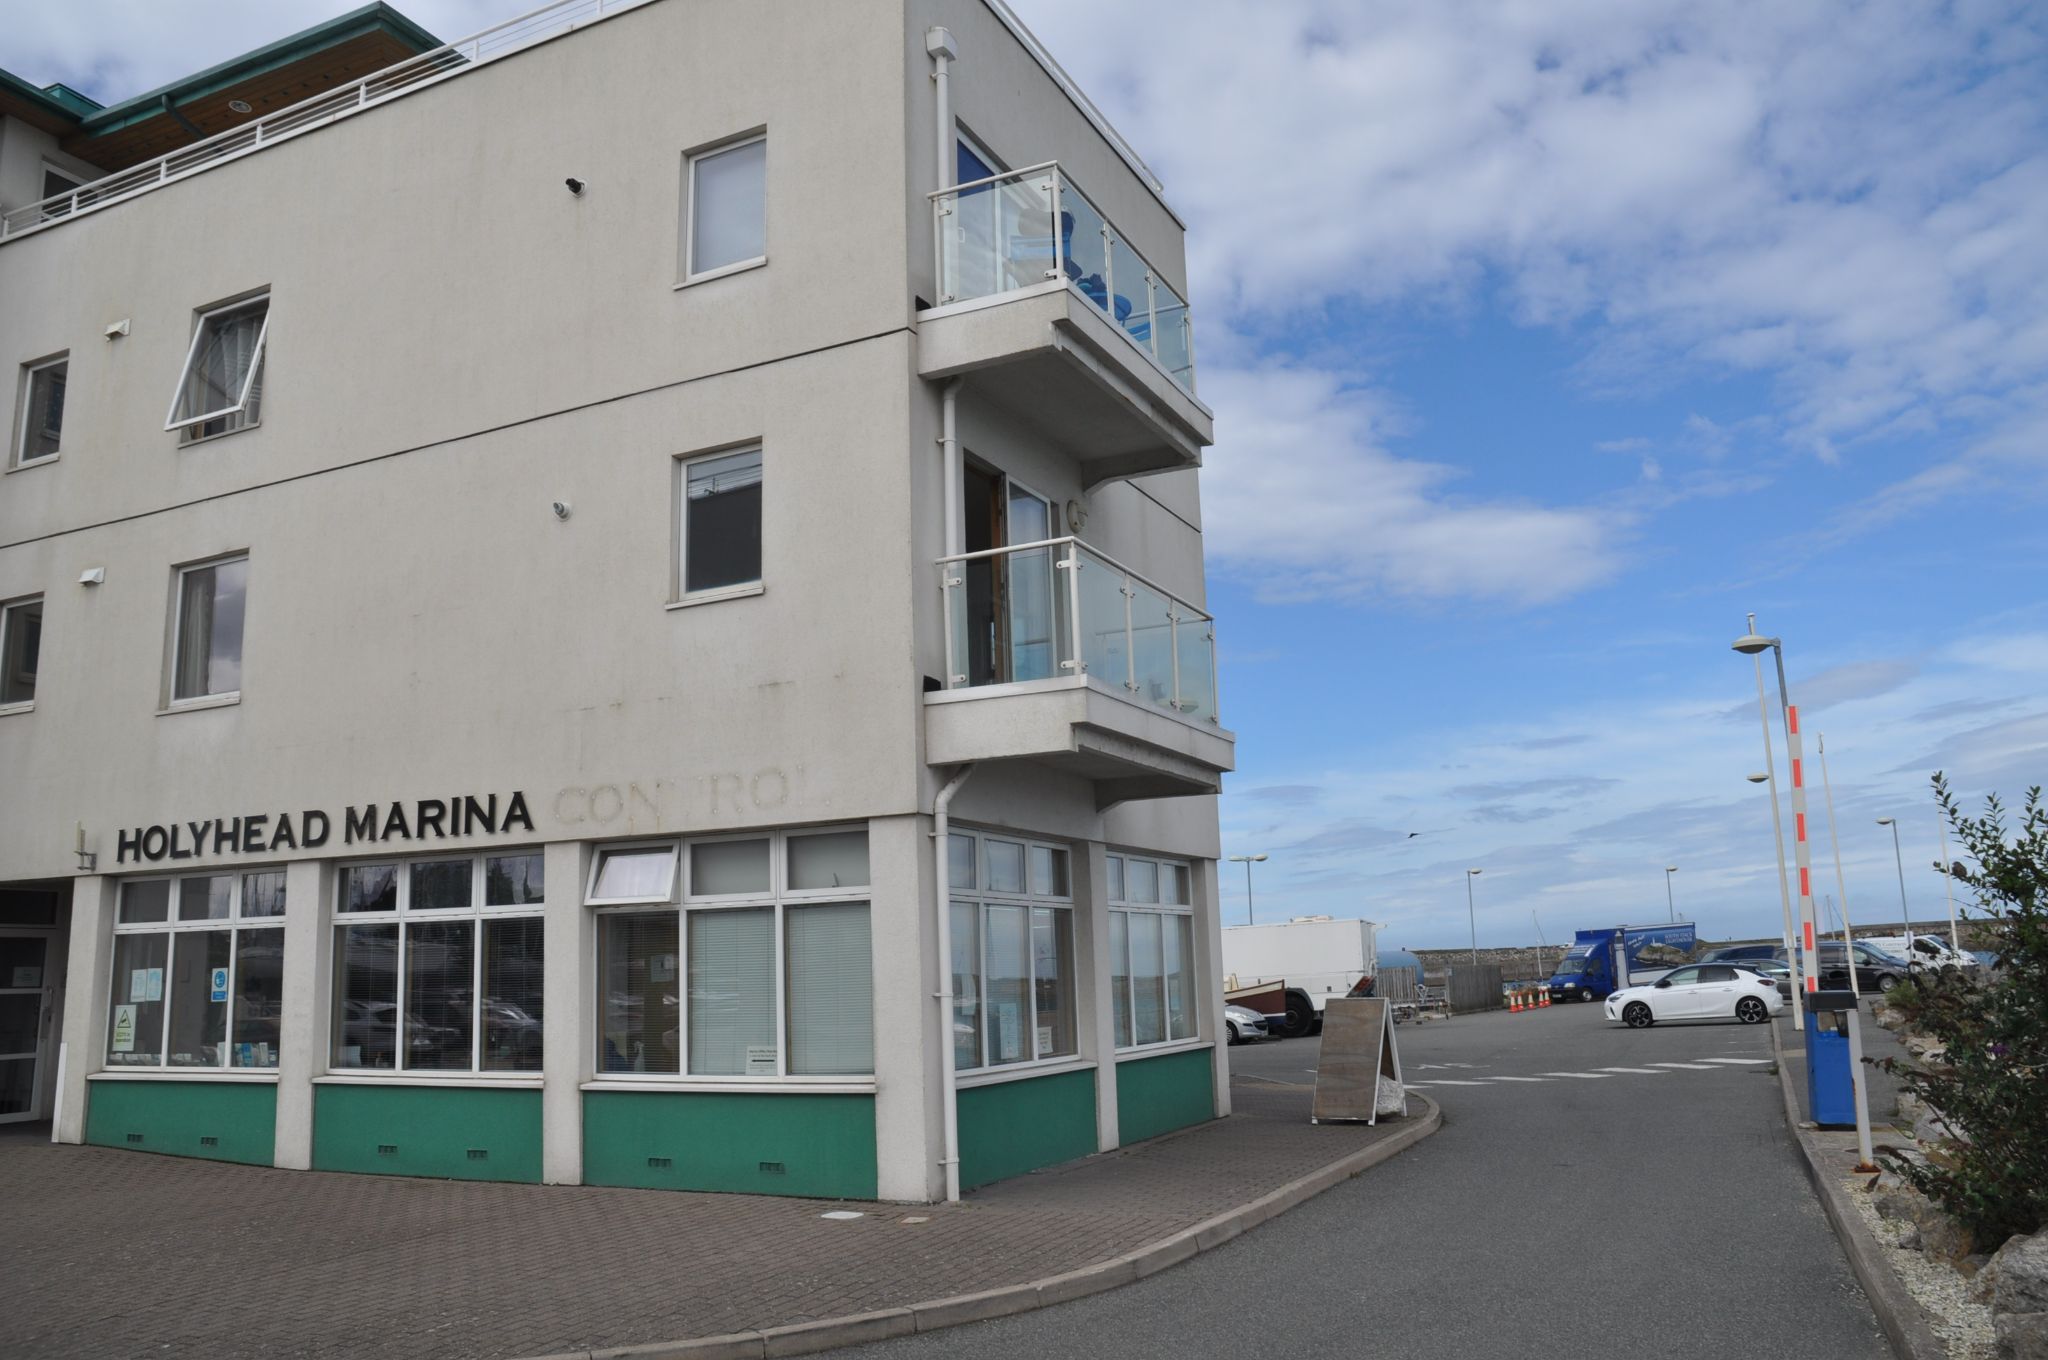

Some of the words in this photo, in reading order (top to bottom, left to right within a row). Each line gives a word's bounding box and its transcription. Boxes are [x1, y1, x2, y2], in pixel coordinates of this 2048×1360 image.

[117, 809, 330, 863] HOLYHEAD
[344, 791, 534, 844] MARINA
[552, 764, 829, 825] CONRO
